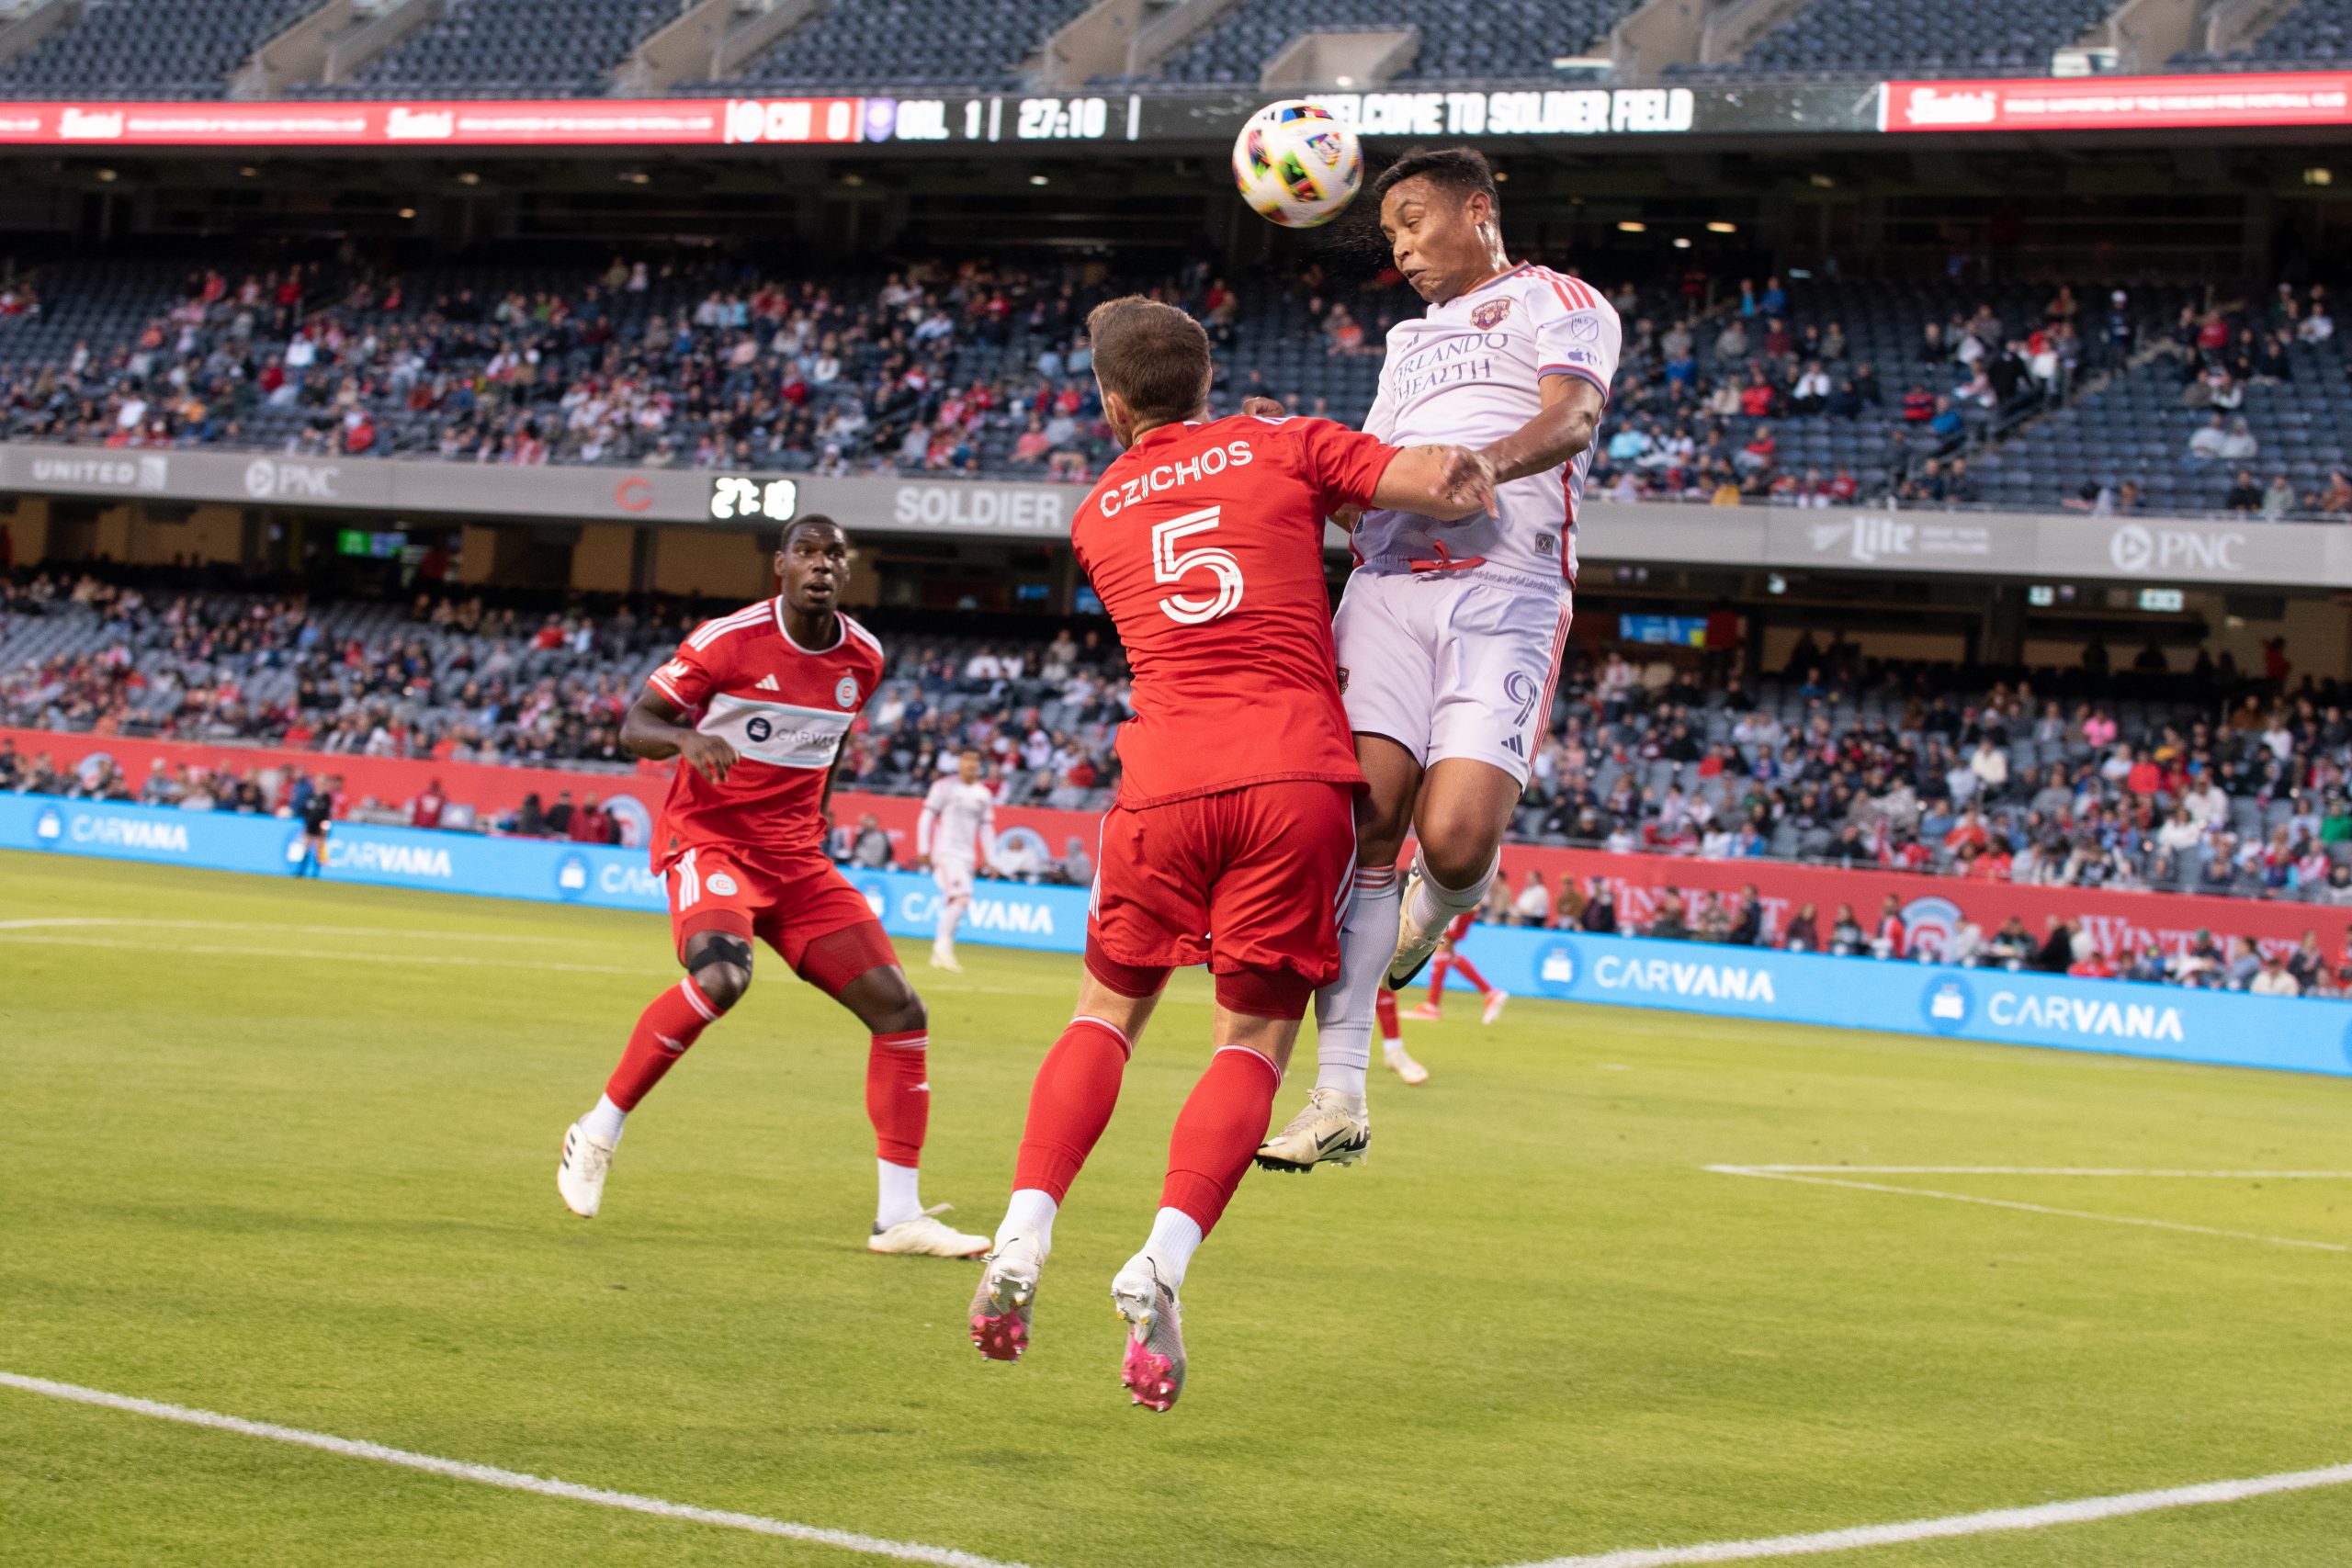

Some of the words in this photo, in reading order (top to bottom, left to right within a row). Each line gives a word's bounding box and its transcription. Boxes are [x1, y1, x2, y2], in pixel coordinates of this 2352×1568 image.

[1018, 97, 1107, 139] 27:10
[1445, 92, 1487, 134] TO
[1612, 88, 1694, 132] FIELD
[33, 459, 136, 484] UNITED
[278, 465, 340, 498] PNC
[1100, 441, 1253, 518] CZICHOS
[895, 486, 1062, 528] SOLDIER
[1151, 505, 1244, 624] 5
[2159, 530, 2246, 571] PNC
[1504, 671, 1537, 728] 9
[71, 814, 189, 852] CARVANA
[328, 839, 452, 878] CARVANA
[900, 891, 1054, 935] CAVANA
[1594, 954, 1775, 1003] CARVANA
[1987, 991, 2184, 1042] CARVANA
